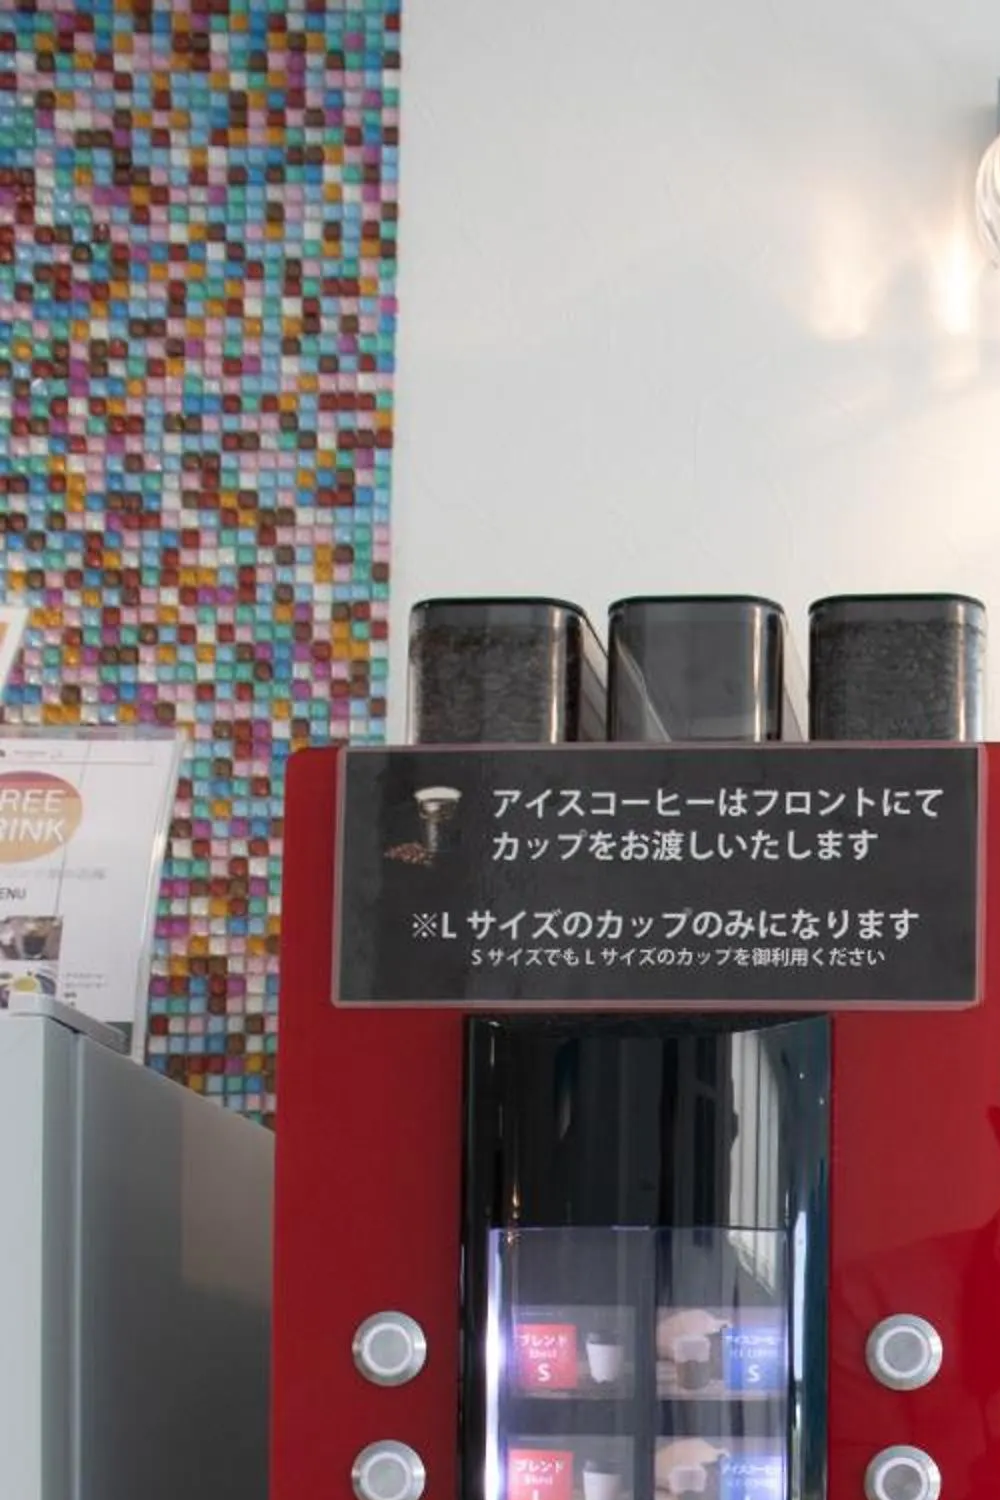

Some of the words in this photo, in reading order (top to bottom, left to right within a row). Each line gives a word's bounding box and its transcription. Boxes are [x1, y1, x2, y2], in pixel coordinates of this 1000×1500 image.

[492, 788, 945, 818] アイスコーヒーはフロントにて
[492, 829, 879, 861] カップをお渡しいたします
[467, 908, 920, 941] サイズのカップのみになります
[487, 947, 580, 967] サイズでも
[600, 947, 886, 968] サイズのカップを御利用ください
[537, 1363, 551, 1383] S
[747, 1364, 761, 1383] S
